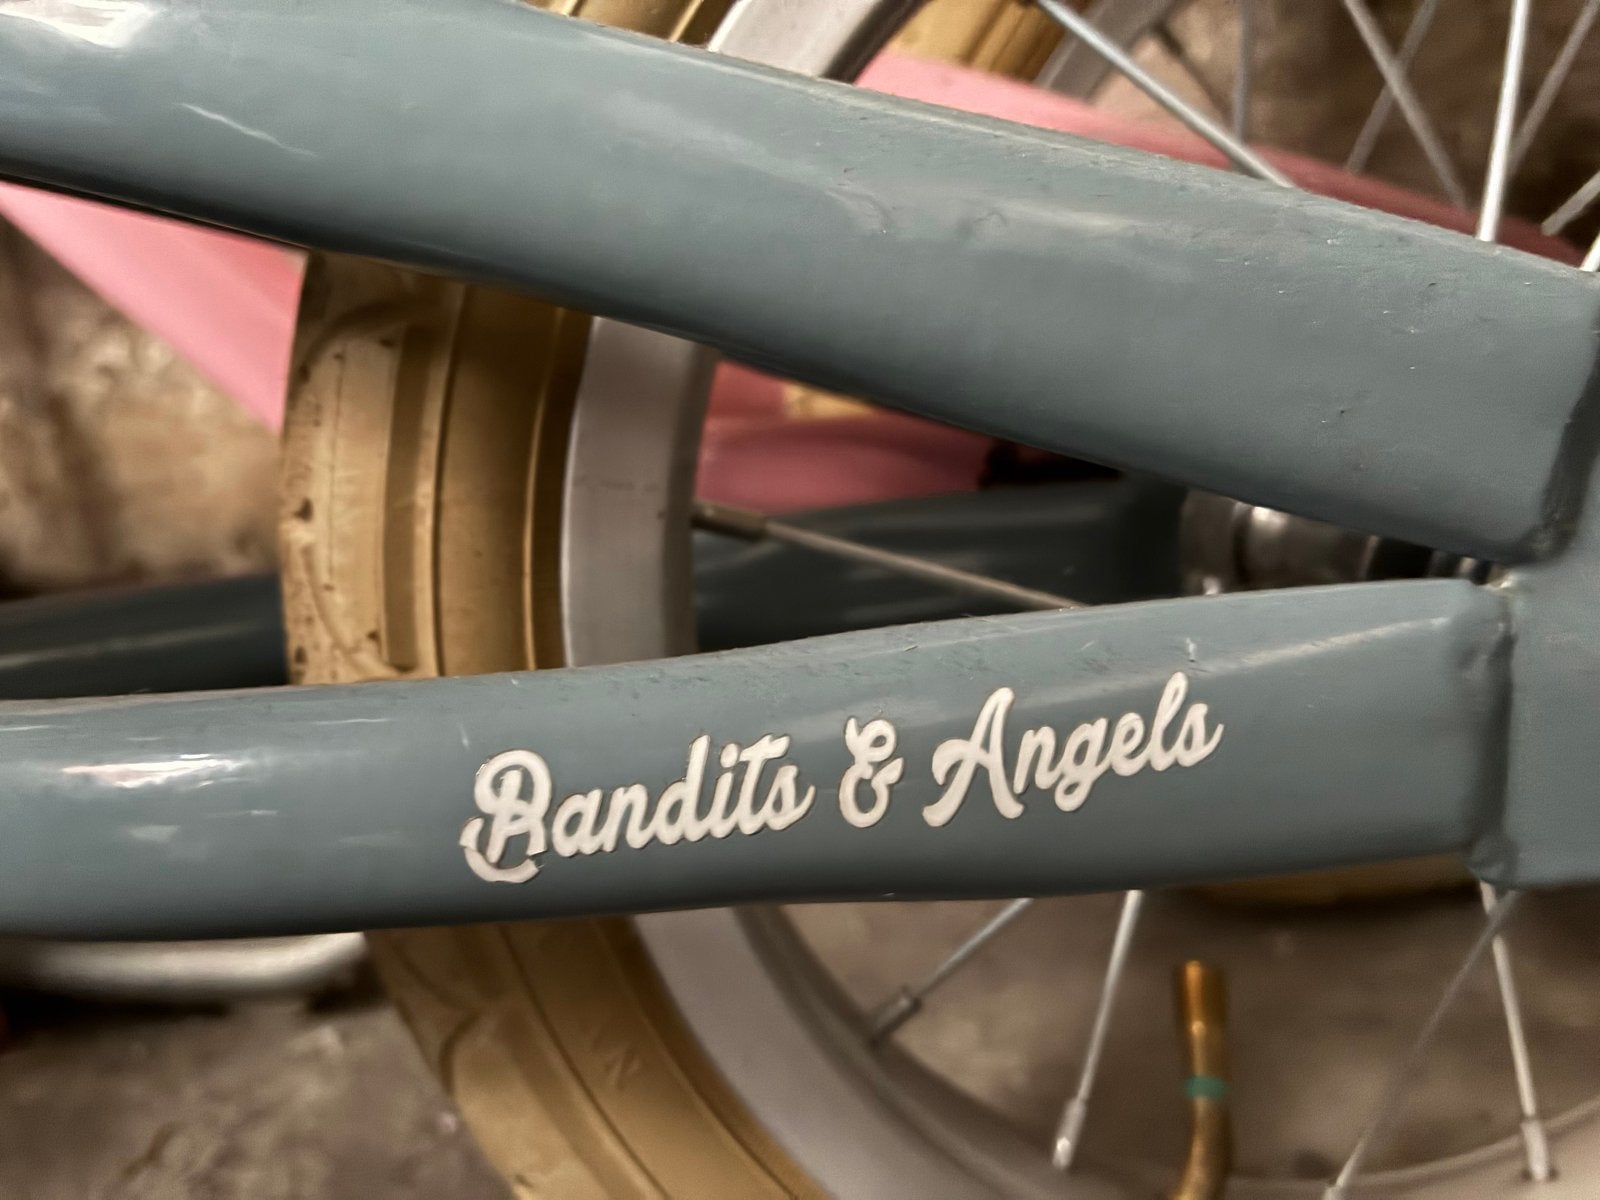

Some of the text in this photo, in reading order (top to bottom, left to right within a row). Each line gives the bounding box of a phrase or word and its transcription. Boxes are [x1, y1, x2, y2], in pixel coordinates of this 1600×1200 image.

[459, 672, 1224, 883] Bandits & Angels
